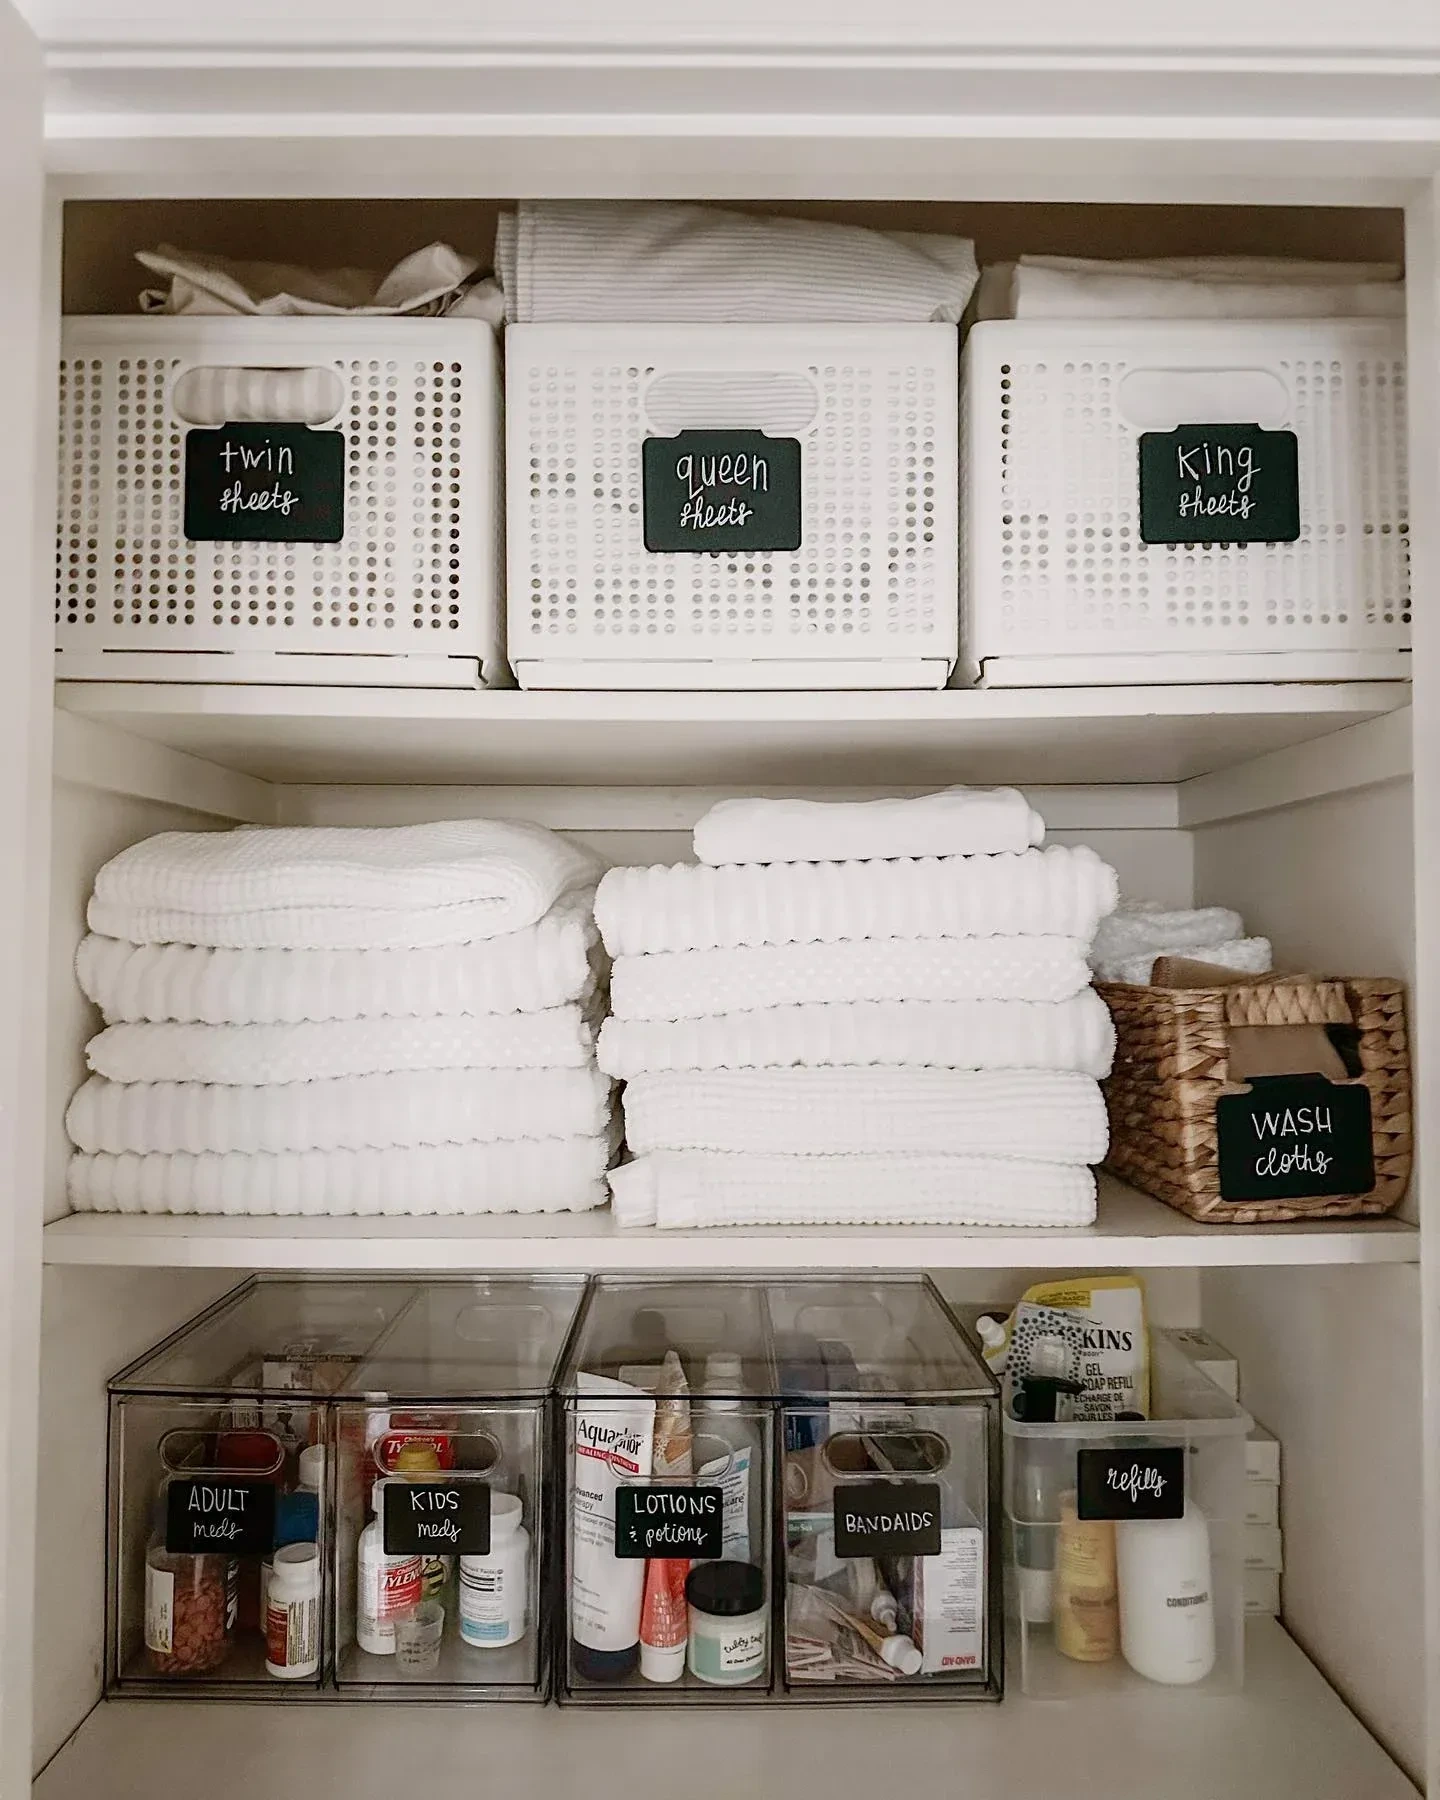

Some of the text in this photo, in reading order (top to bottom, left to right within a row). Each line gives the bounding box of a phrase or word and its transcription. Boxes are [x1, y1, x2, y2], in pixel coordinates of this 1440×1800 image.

[219, 439, 293, 475] twin
[676, 453, 768, 500] queen
[219, 480, 299, 516] sheets
[1178, 484, 1257, 520] sheets
[680, 495, 754, 530] sheets
[1251, 1106, 1332, 1140] WASH
[1255, 1143, 1334, 1176] cloths
[1082, 1329, 1132, 1351] KINS
[1085, 1363, 1103, 1376] GEL
[1082, 1375, 1134, 1391] SOAP REFILL
[1074, 1392, 1124, 1403] ECHARGE DE
[1084, 1403, 1112, 1412] SAVON
[1073, 1413, 1096, 1421] POUR
[577, 1419, 642, 1455] Aquaphor
[1106, 1463, 1168, 1503] refills
[188, 1485, 249, 1512] ADULT
[410, 1490, 460, 1511] KIDS
[634, 1493, 716, 1515] LOTIONS
[193, 1517, 243, 1540] meds
[417, 1518, 462, 1543] meds
[645, 1522, 709, 1548] potions
[845, 1511, 934, 1534] BANDAIDS
